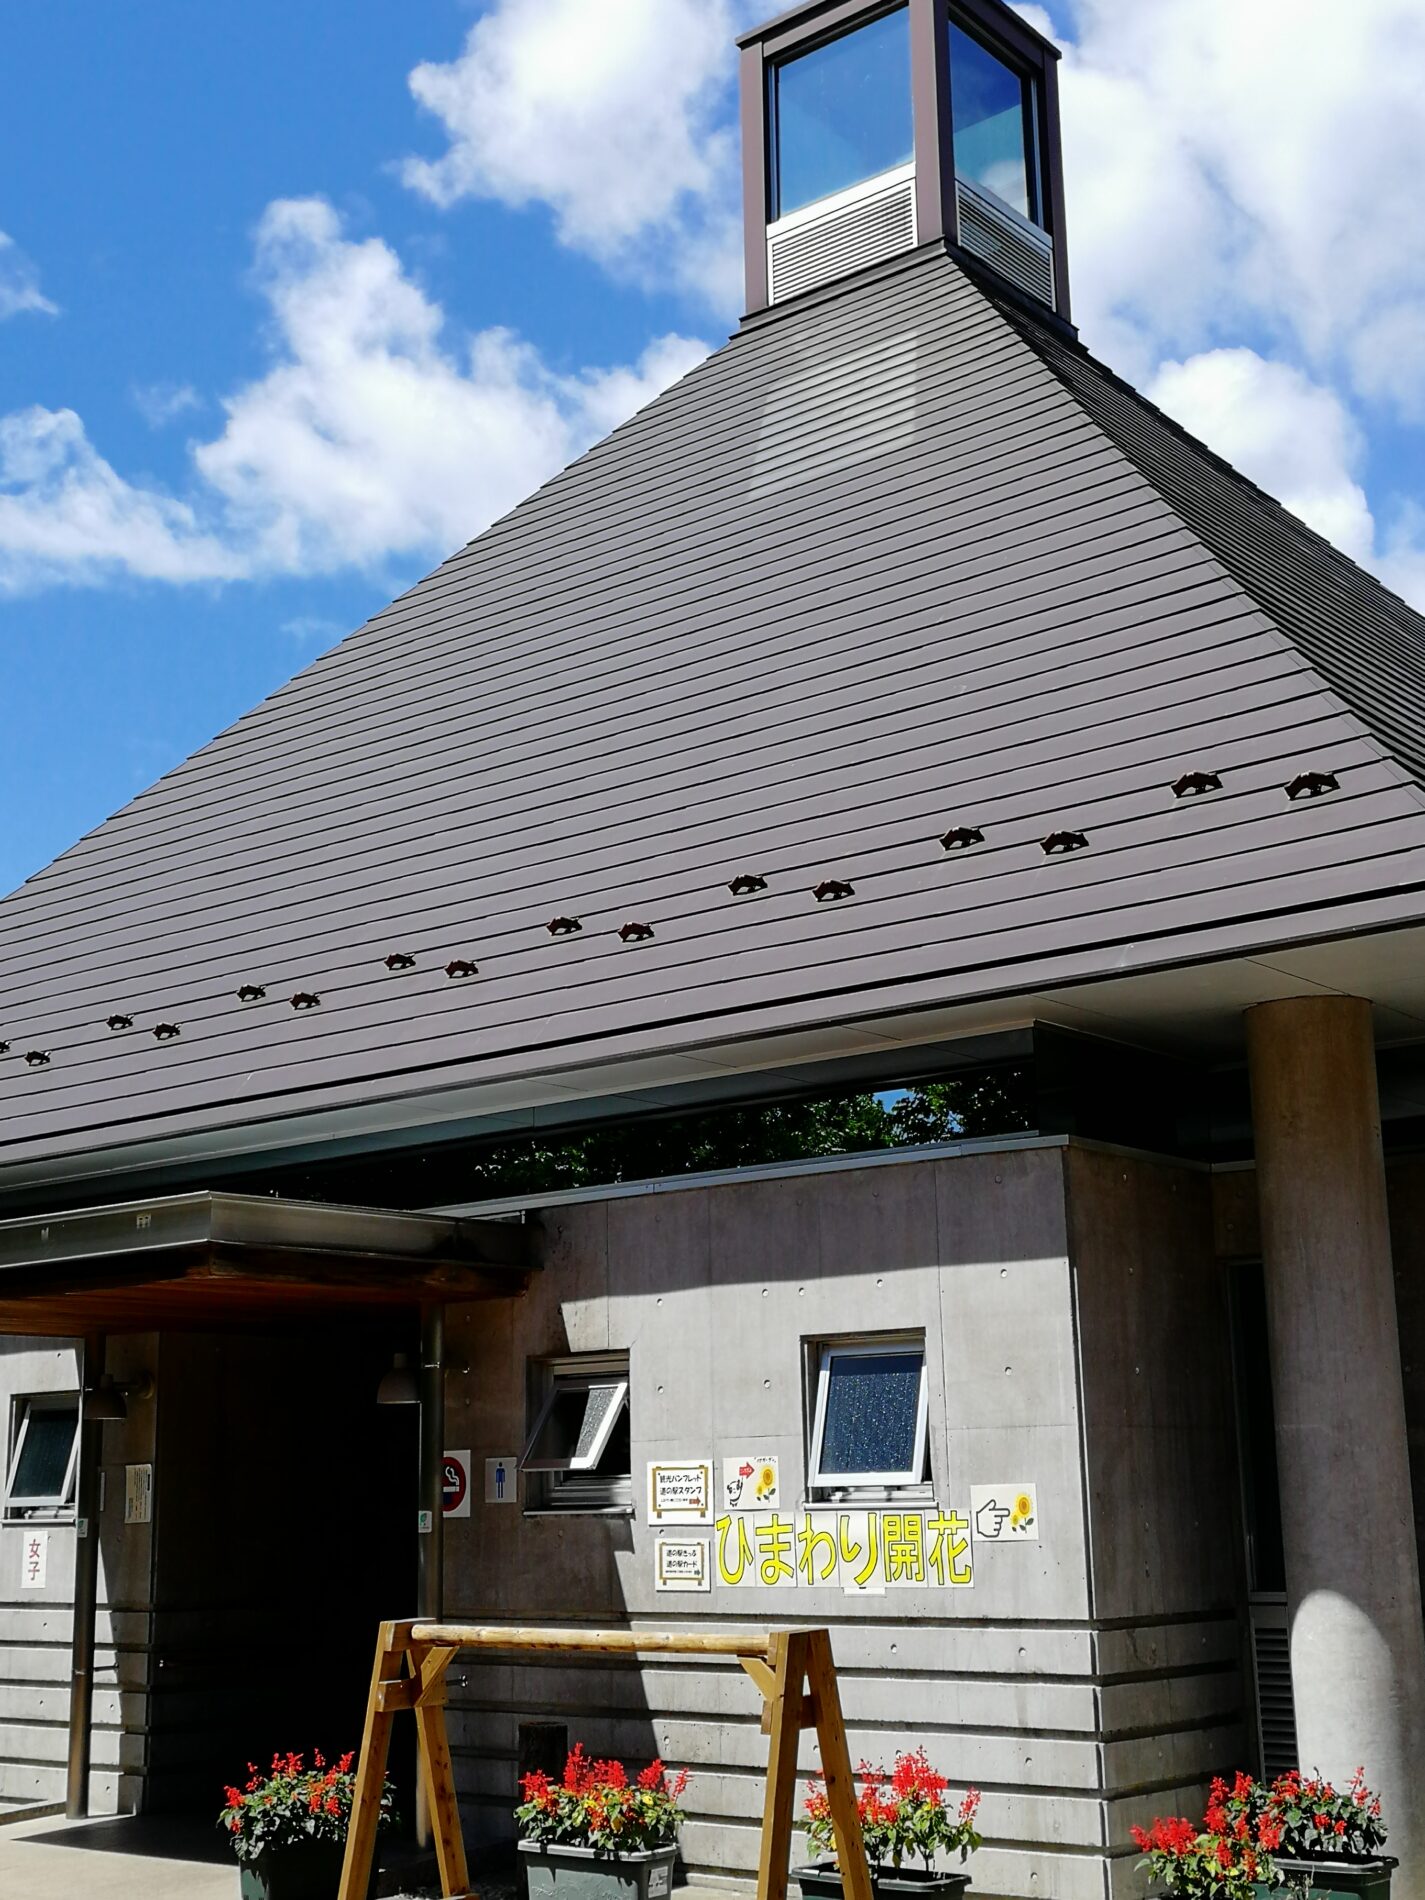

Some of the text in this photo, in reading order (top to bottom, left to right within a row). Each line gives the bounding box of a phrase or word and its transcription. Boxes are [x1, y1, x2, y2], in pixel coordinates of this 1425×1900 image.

[660, 1474, 702, 1483] 観光パンフレット
[660, 1486, 702, 1495] 道の駅スタンプ
[28, 1539, 41, 1581] 女子
[716, 1511, 972, 1586] ひまわり開花
